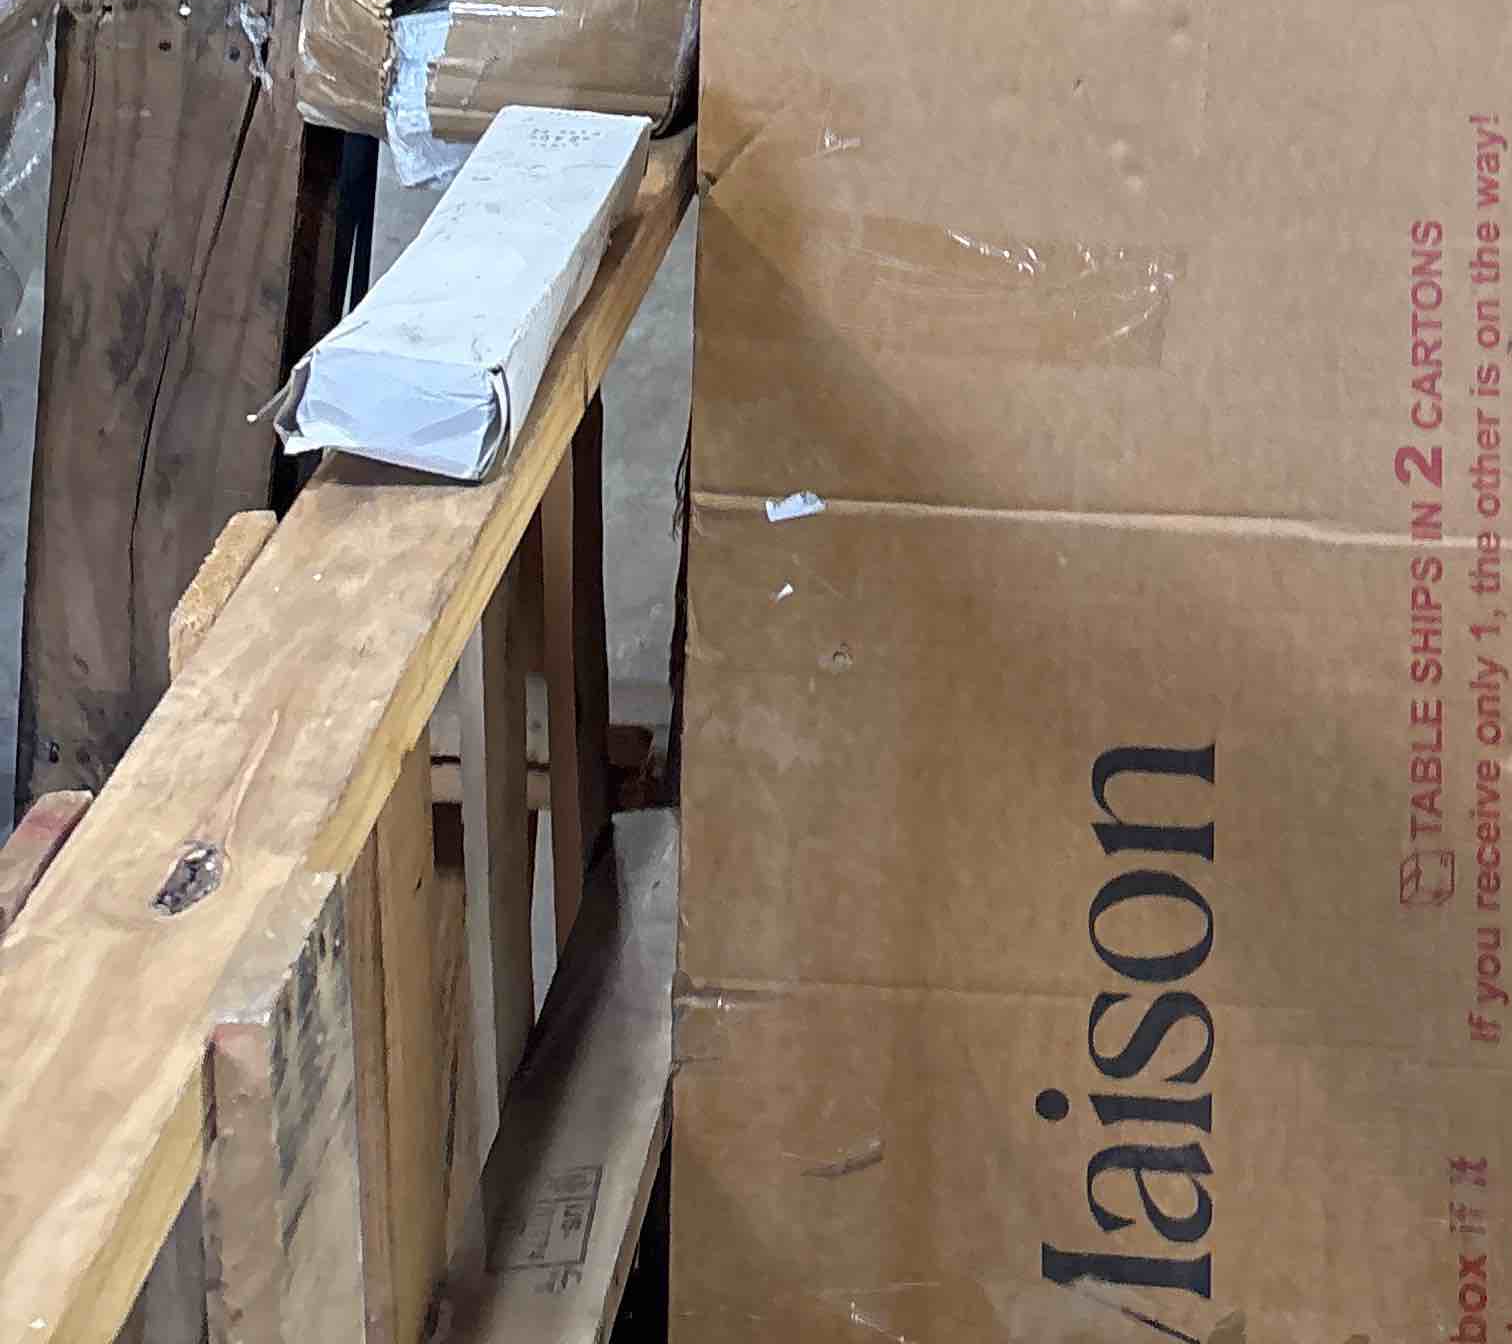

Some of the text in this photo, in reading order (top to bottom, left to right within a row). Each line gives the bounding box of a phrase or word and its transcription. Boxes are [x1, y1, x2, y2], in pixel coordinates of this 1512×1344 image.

[1394, 219, 1444, 840] TABLE SHIPS IN 2 CARTONS
[1467, 112, 1509, 1043] If you receive only 1, the other is on the way!
[1449, 1254, 1488, 1344] box
